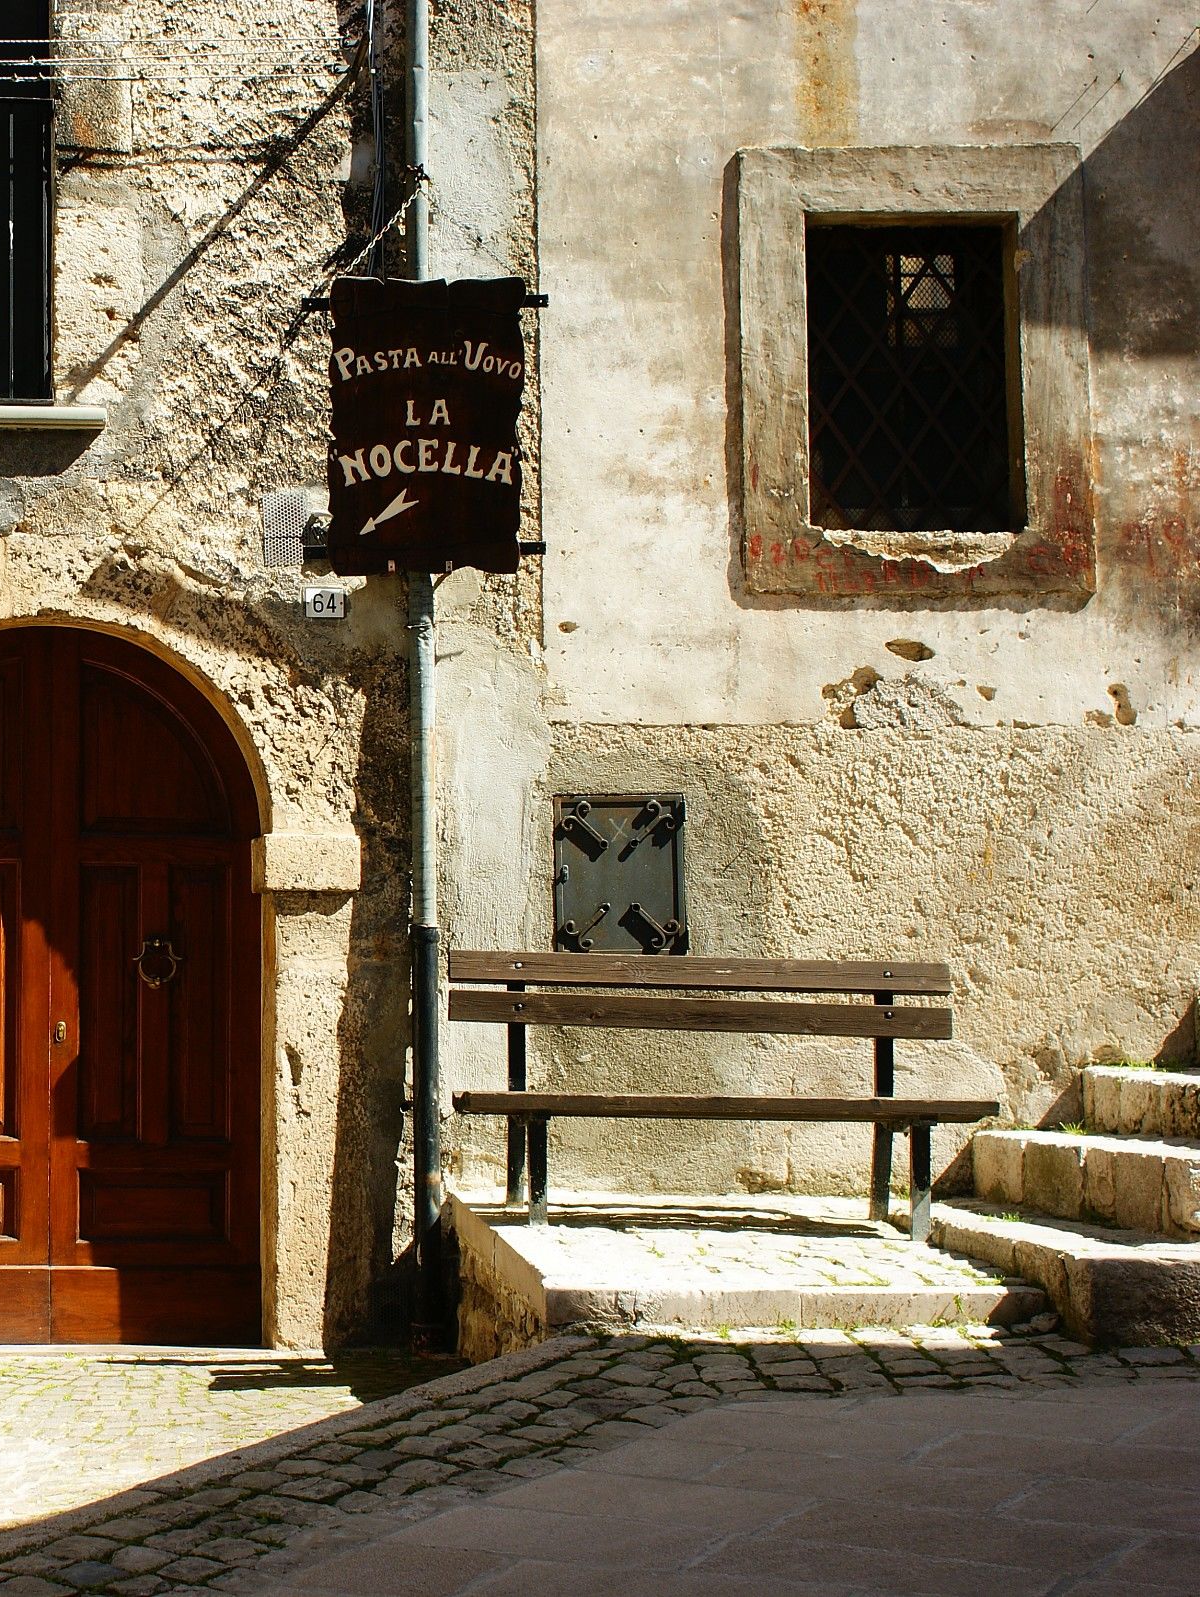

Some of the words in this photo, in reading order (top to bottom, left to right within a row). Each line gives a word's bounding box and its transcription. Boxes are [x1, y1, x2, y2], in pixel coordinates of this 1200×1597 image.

[333, 347, 422, 381] PASTA
[405, 399, 451, 427] LA
[312, 593, 337, 613] 64
